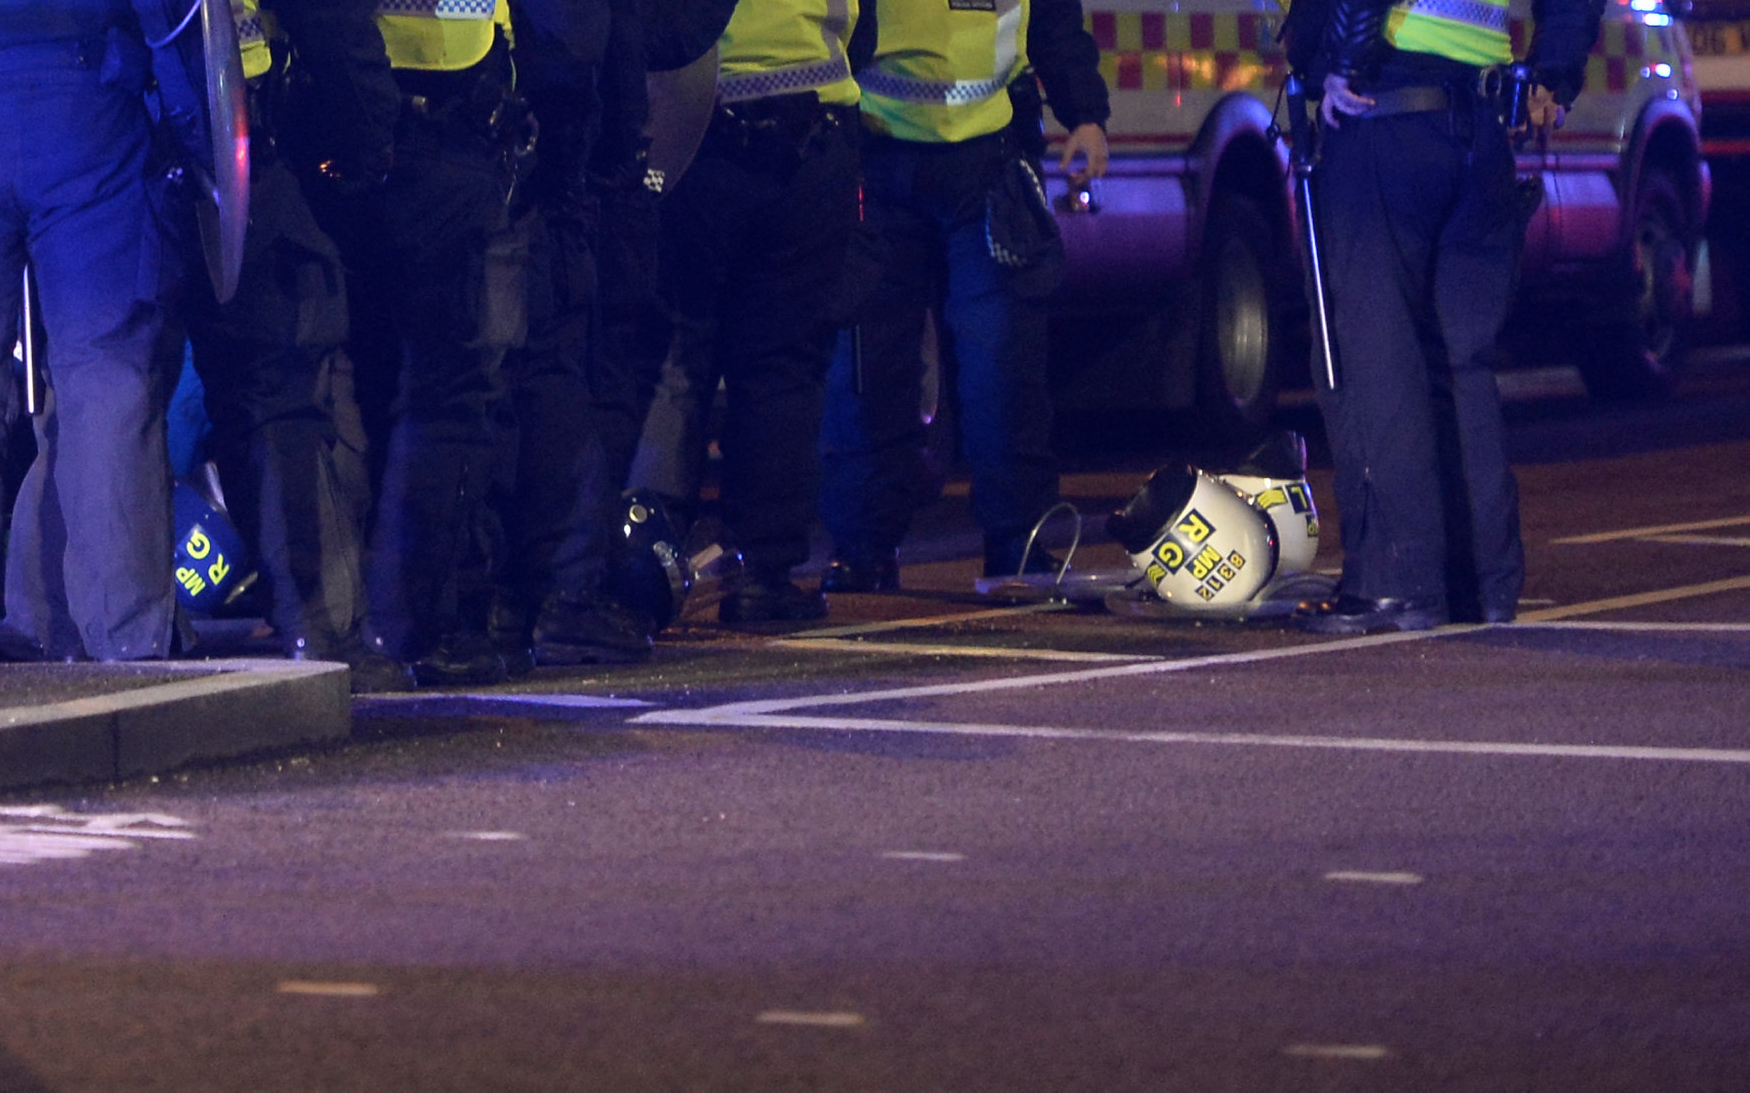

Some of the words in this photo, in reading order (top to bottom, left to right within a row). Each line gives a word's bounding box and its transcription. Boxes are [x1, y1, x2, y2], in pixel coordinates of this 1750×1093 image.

[1179, 513, 1210, 544] R
[186, 530, 211, 560] G
[1158, 541, 1184, 568] G
[208, 553, 230, 586] R
[1192, 546, 1221, 579] MP
[175, 566, 206, 597] MP
